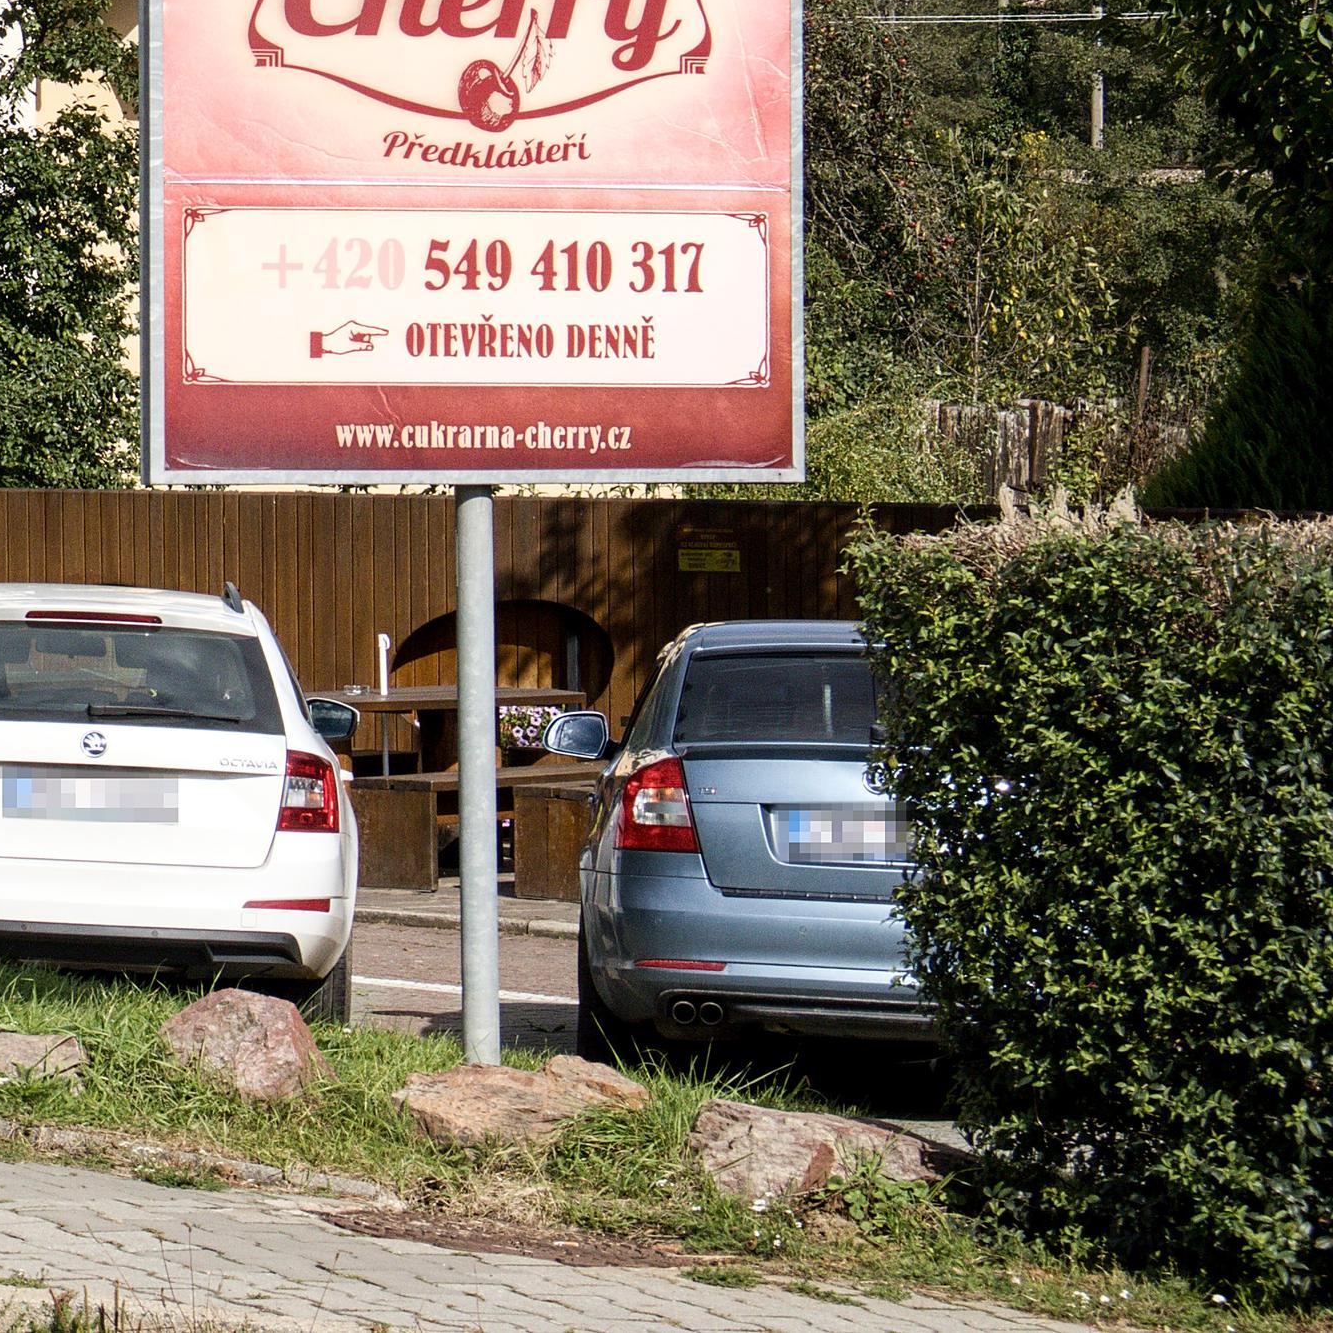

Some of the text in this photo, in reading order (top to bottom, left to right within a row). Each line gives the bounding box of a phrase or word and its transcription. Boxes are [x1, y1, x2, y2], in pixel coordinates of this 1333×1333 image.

[383, 131, 591, 169] Předklášteří
[261, 237, 705, 293] +420 549 410 317
[406, 314, 655, 359] OTEVŘENO DENNĚ
[336, 421, 632, 451] www.cukrarna-cherry.cz
[219, 758, 278, 770] OCTAVIA
